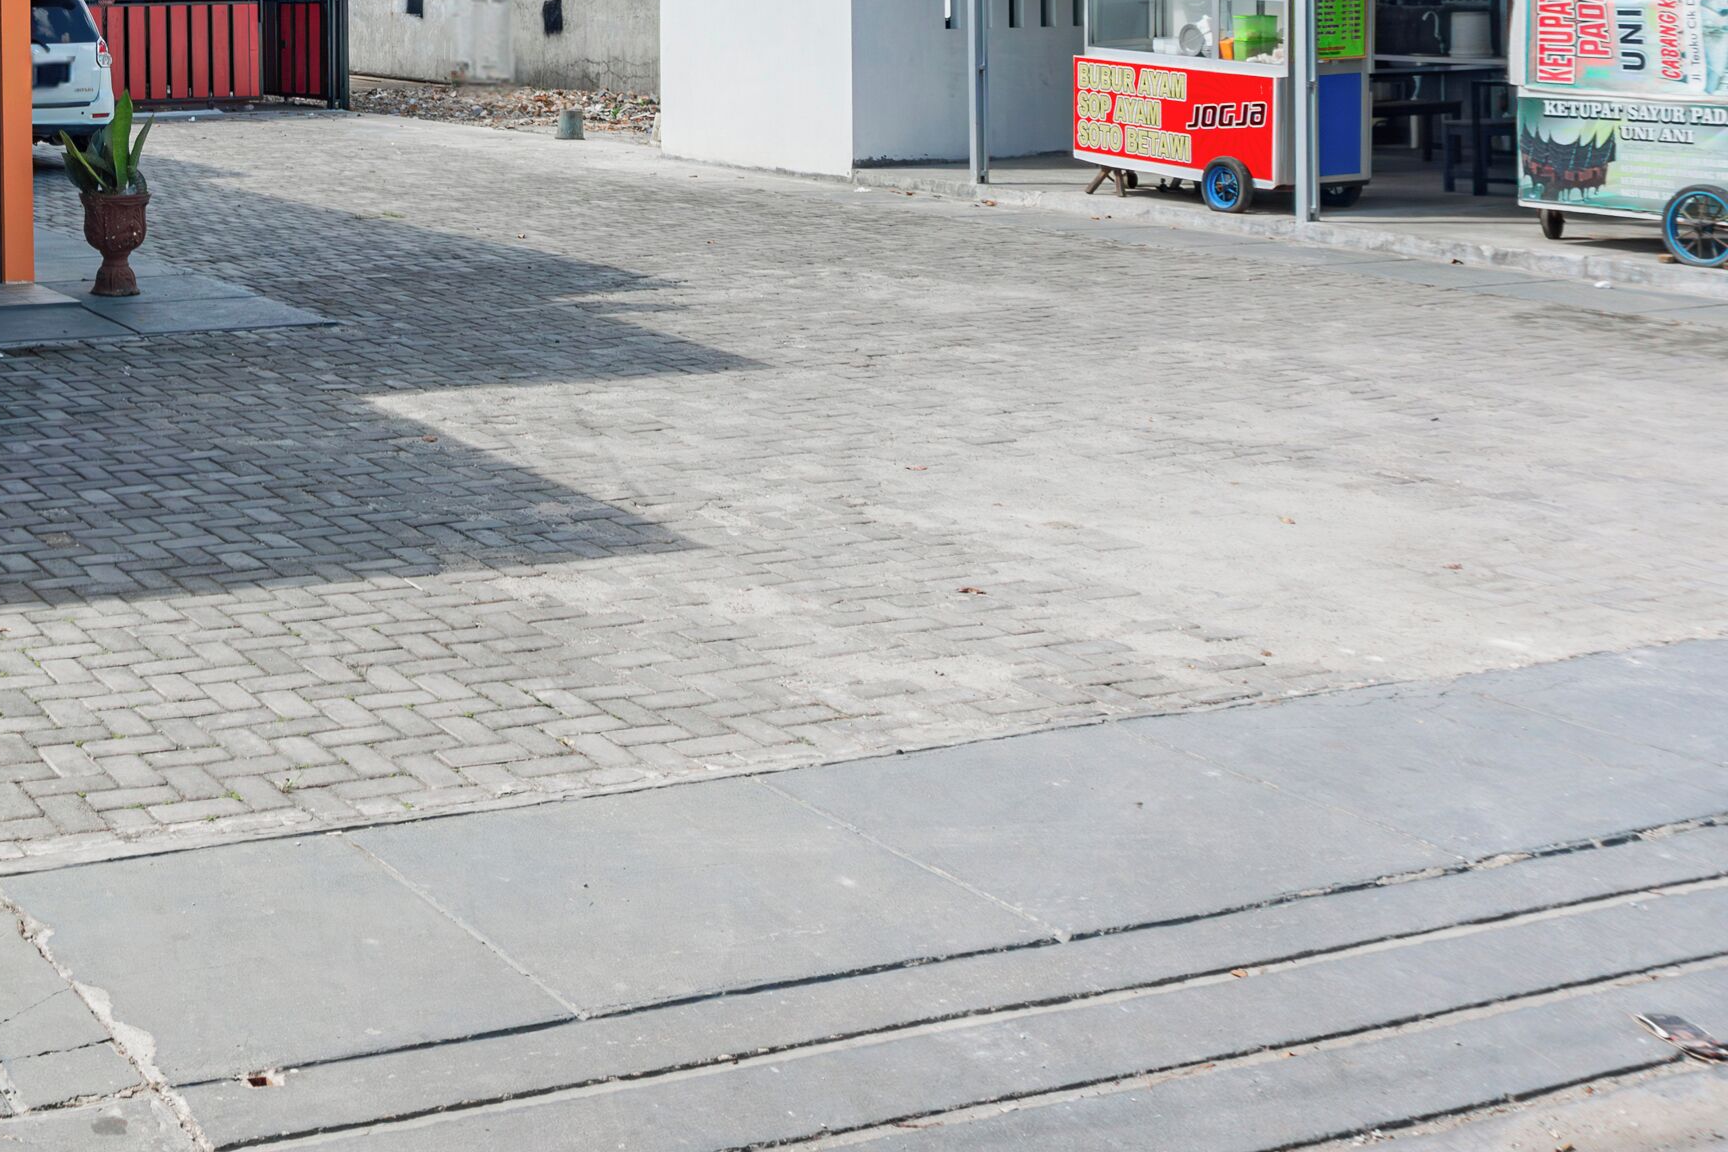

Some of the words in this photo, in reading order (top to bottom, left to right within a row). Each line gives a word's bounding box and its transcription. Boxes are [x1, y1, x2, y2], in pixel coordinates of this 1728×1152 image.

[1686, 10, 1697, 29] Cik
[1616, 8, 1646, 71] UNI
[1657, 13, 1682, 81] CABANG
[1686, 33, 1700, 65] Teuku
[1078, 62, 1135, 93] BUBUR
[1138, 70, 1186, 100] AYAM
[1078, 91, 1111, 119] SOP
[1113, 96, 1161, 128] AYAM
[1543, 100, 1623, 120] KETUPAT
[1627, 104, 1686, 124] SAYUR
[1690, 107, 1728, 126] PAD
[1078, 120, 1123, 151] SOTO
[1125, 125, 1192, 162] BETAWI
[1620, 125, 1657, 141] UNI
[1658, 129, 1695, 144] ANI
